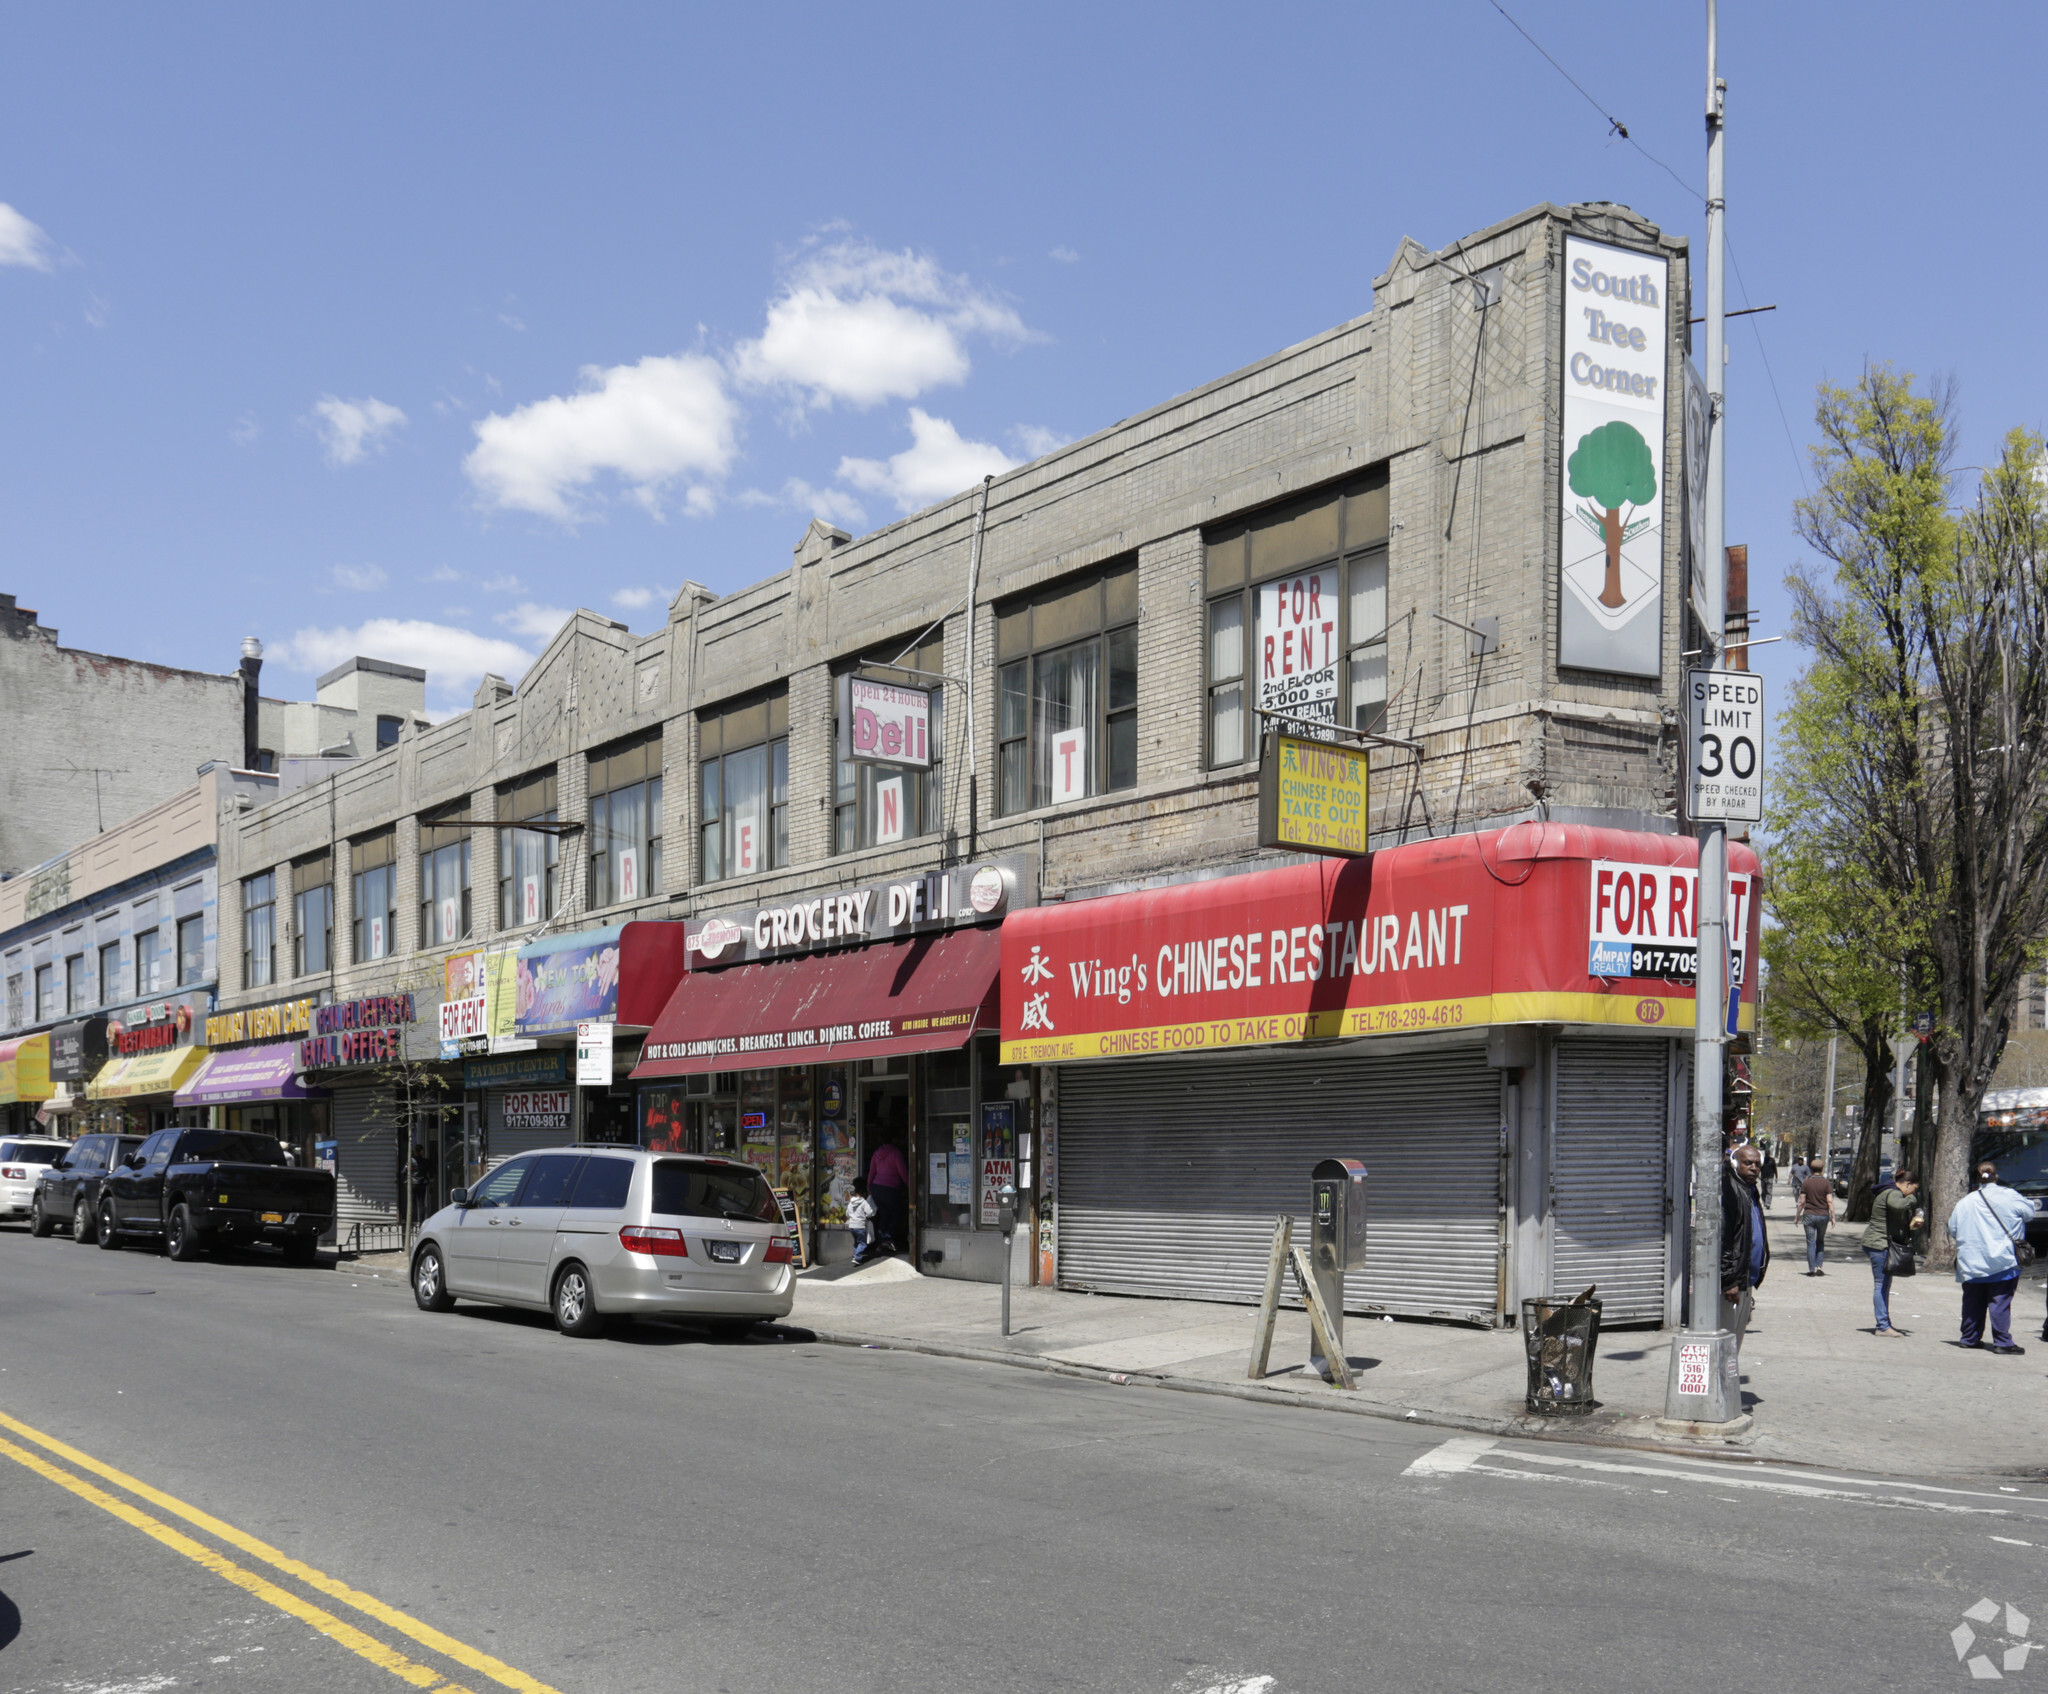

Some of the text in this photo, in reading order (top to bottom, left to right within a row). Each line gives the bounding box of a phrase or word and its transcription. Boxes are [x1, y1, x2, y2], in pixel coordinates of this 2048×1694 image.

[1571, 257, 1660, 308] South
[1583, 306, 1648, 353] Tree
[1570, 351, 1658, 398] Corner
[1278, 575, 1321, 628] FOR
[1264, 621, 1333, 680] RENT
[1263, 669, 1335, 695] 2nd FLOOR
[1315, 687, 1332, 698] SF
[1694, 683, 1759, 704] SPEED
[853, 683, 928, 709] open 24 HOURS
[1297, 700, 1335, 718] REALTY
[1701, 708, 1752, 729] LIMIT
[855, 707, 926, 759] Deli
[1298, 743, 1347, 784] WING'S
[1697, 733, 1756, 779] 30
[1282, 779, 1361, 806] CHINESE FOOD
[1694, 784, 1757, 797] SPEED CHECKED
[1706, 797, 1746, 808] BY RADAR
[1284, 799, 1360, 825] TAKE OUT
[374, 924, 381, 954] F
[527, 883, 536, 918] R
[624, 857, 633, 894] R
[741, 825, 752, 868] E
[883, 788, 897, 835] N
[1060, 739, 1076, 792] T
[1282, 818, 1361, 849] Tel: 299-4613
[754, 890, 873, 950] GROCERY
[888, 874, 949, 927] DELI
[1596, 870, 1747, 941] FOR RT
[688, 935, 700, 949] 875
[1069, 904, 1469, 1005] Wing's CHINESE RESTAURANT
[540, 967, 567, 988] NEW
[1593, 962, 1628, 974] REALTY
[206, 998, 311, 1046] PRIMARY VISION CARE
[342, 1001, 357, 1029] DEL
[443, 1004, 458, 1038] FOR
[461, 999, 485, 1035] RENT
[902, 1021, 912, 1030] ATM
[913, 1018, 928, 1029] INSIDE
[931, 1017, 939, 1027] WE
[939, 1015, 957, 1026] ACCEPT
[1641, 1003, 1660, 1020] 879
[119, 1024, 174, 1053] RESTAURANT
[301, 1035, 335, 1067] DENTAL
[342, 1028, 397, 1061] OFFICE
[648, 1020, 893, 1059] HOT & COLD SANDWICHES. BREAKFAST. LUNCH. DINNER. COFFEE.
[1099, 1030, 1159, 1055] CHINESE
[1163, 1025, 1207, 1050] FOOD
[1210, 1023, 1231, 1043] TO
[1236, 1018, 1279, 1041] TAKE
[1283, 1015, 1320, 1038] OUT
[1031, 1043, 1060, 1058] TREMONT
[471, 1062, 515, 1078] PAYMENT
[517, 1056, 559, 1074] CENTER
[504, 1093, 569, 1113] FOR RENT
[650, 1094, 667, 1108] TOP
[506, 1115, 567, 1127] 917-709-9812
[741, 1116, 762, 1127] OPEN
[326, 1149, 333, 1159] P
[984, 1160, 1012, 1175] ATM
[1681, 1345, 1708, 1355] CASH
[1683, 1364, 1706, 1373] (516)
[1683, 1374, 1703, 1383] 232
[1680, 1384, 1706, 1393] 0007
